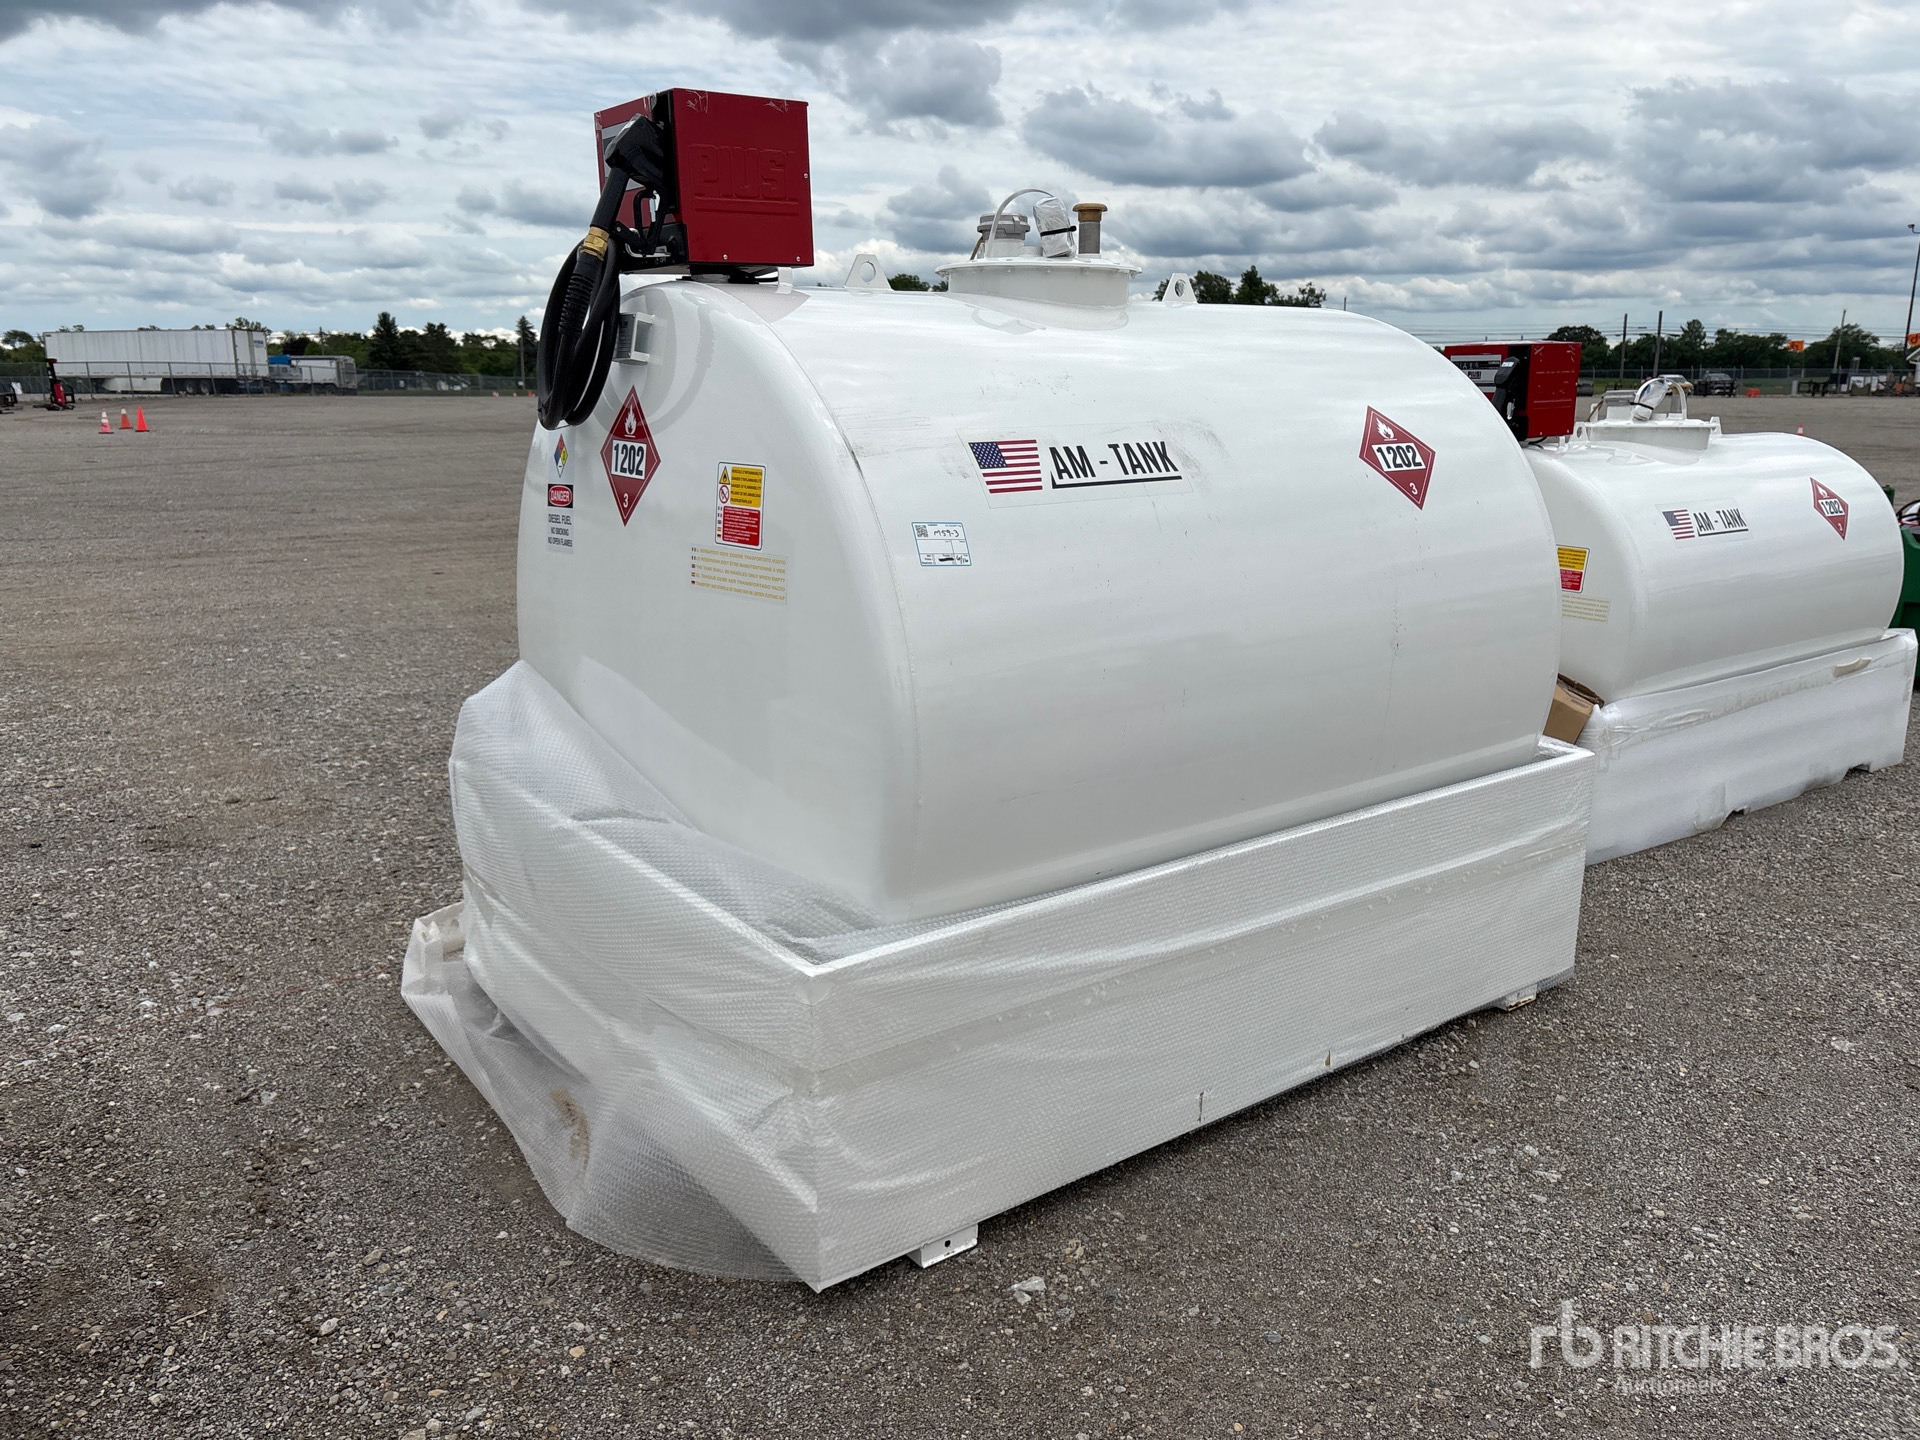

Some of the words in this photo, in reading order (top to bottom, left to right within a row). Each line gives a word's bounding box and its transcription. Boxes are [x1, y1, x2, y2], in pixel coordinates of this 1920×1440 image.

[614, 443, 645, 476] 1202
[1049, 445, 1096, 480] AM
[1107, 441, 1179, 475] TANK
[1376, 445, 1423, 469] 1202
[550, 490, 570, 502] DANGER
[1409, 482, 1418, 495] 3
[623, 493, 629, 508] 3
[1821, 500, 1843, 515] 1202
[1693, 512, 1715, 531] AM
[1716, 508, 1747, 529] TANK
